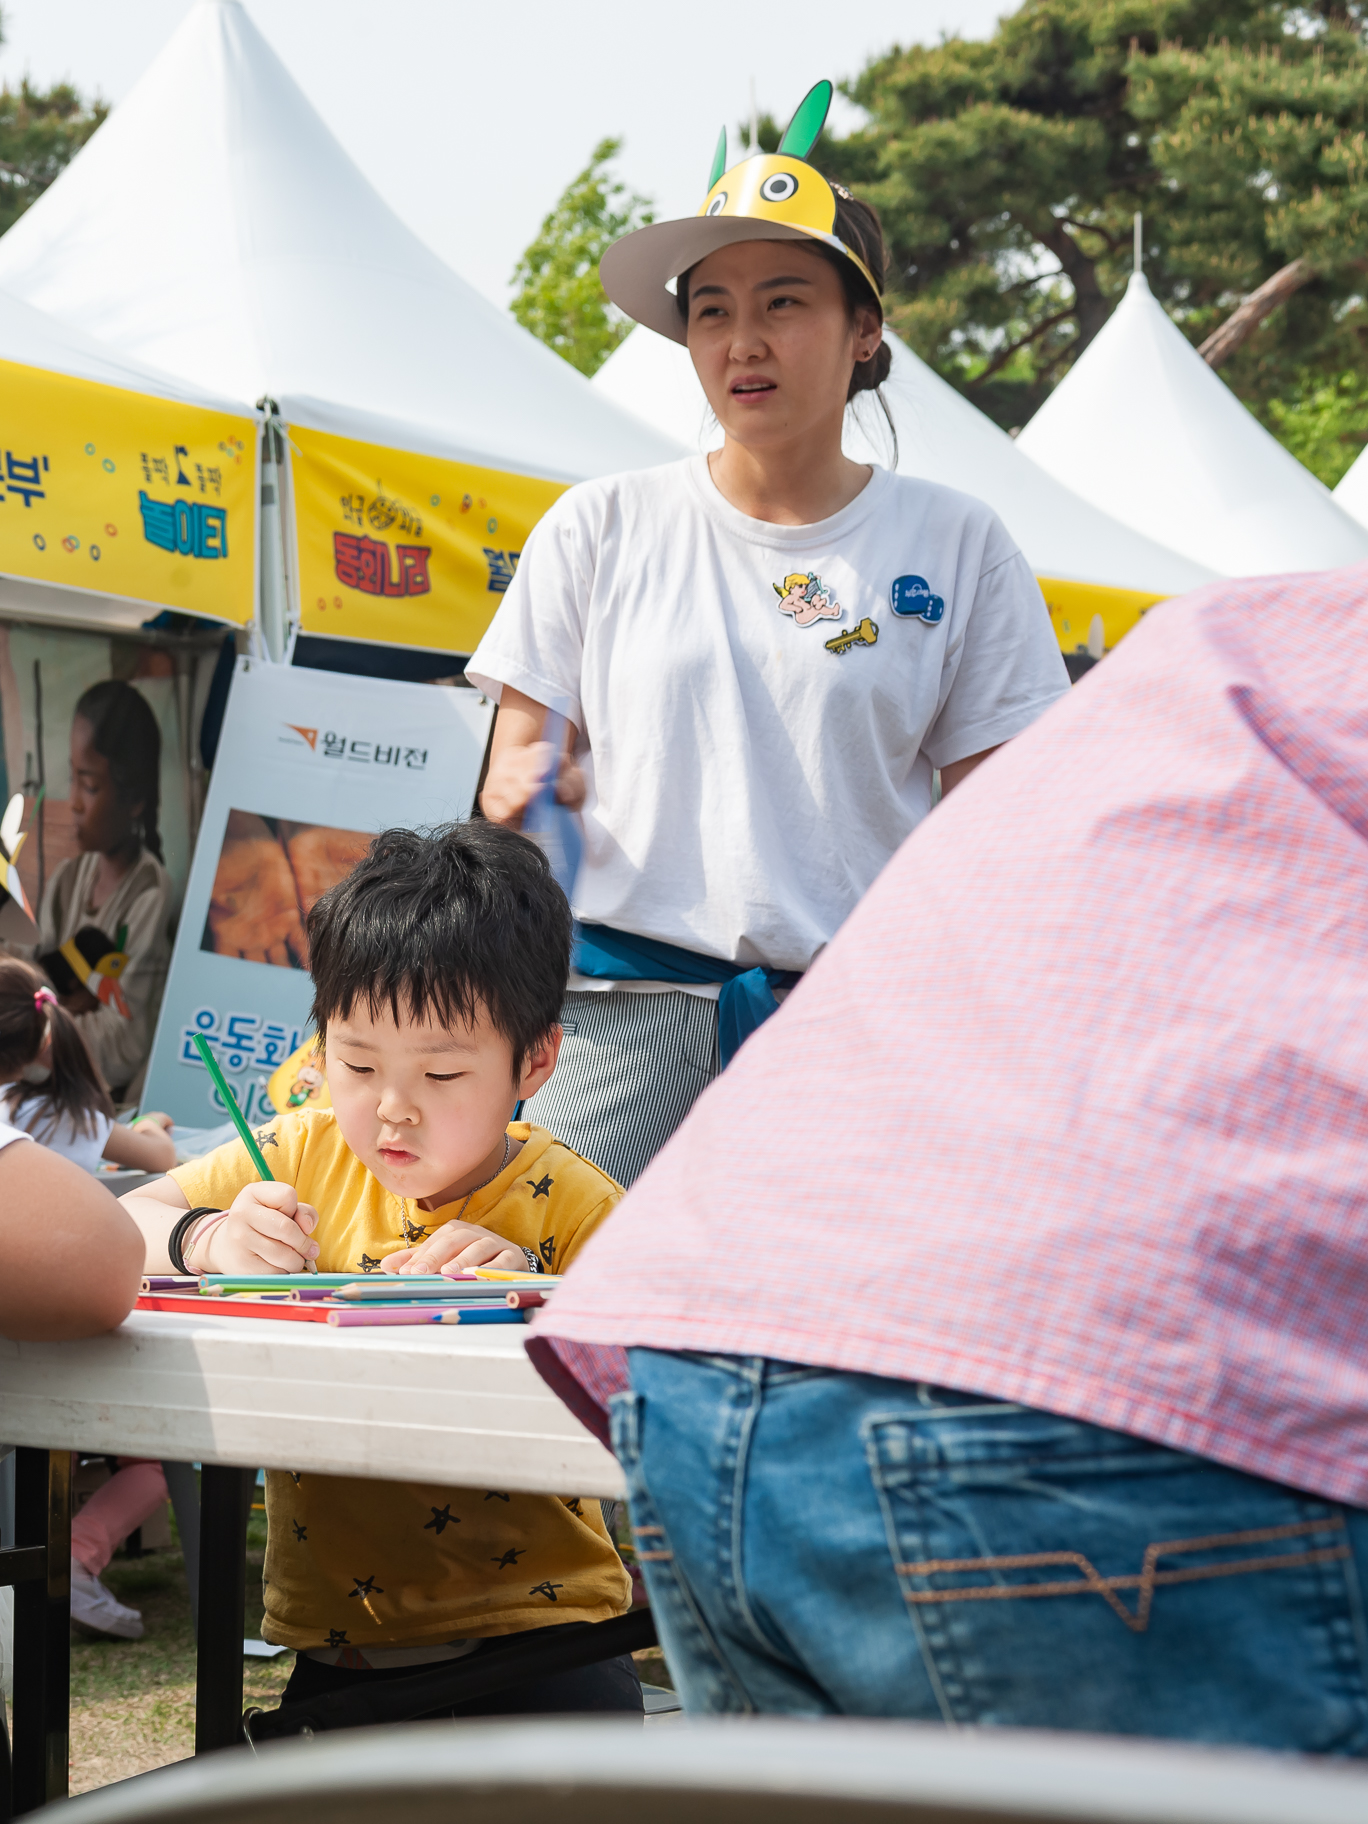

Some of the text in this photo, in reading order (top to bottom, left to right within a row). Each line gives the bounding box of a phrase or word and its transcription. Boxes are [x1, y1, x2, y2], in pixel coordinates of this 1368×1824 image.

[137, 489, 230, 560] 놀이터
[332, 530, 432, 599] 동화나라
[482, 546, 521, 592] 월
[323, 730, 428, 771] 월드비전
